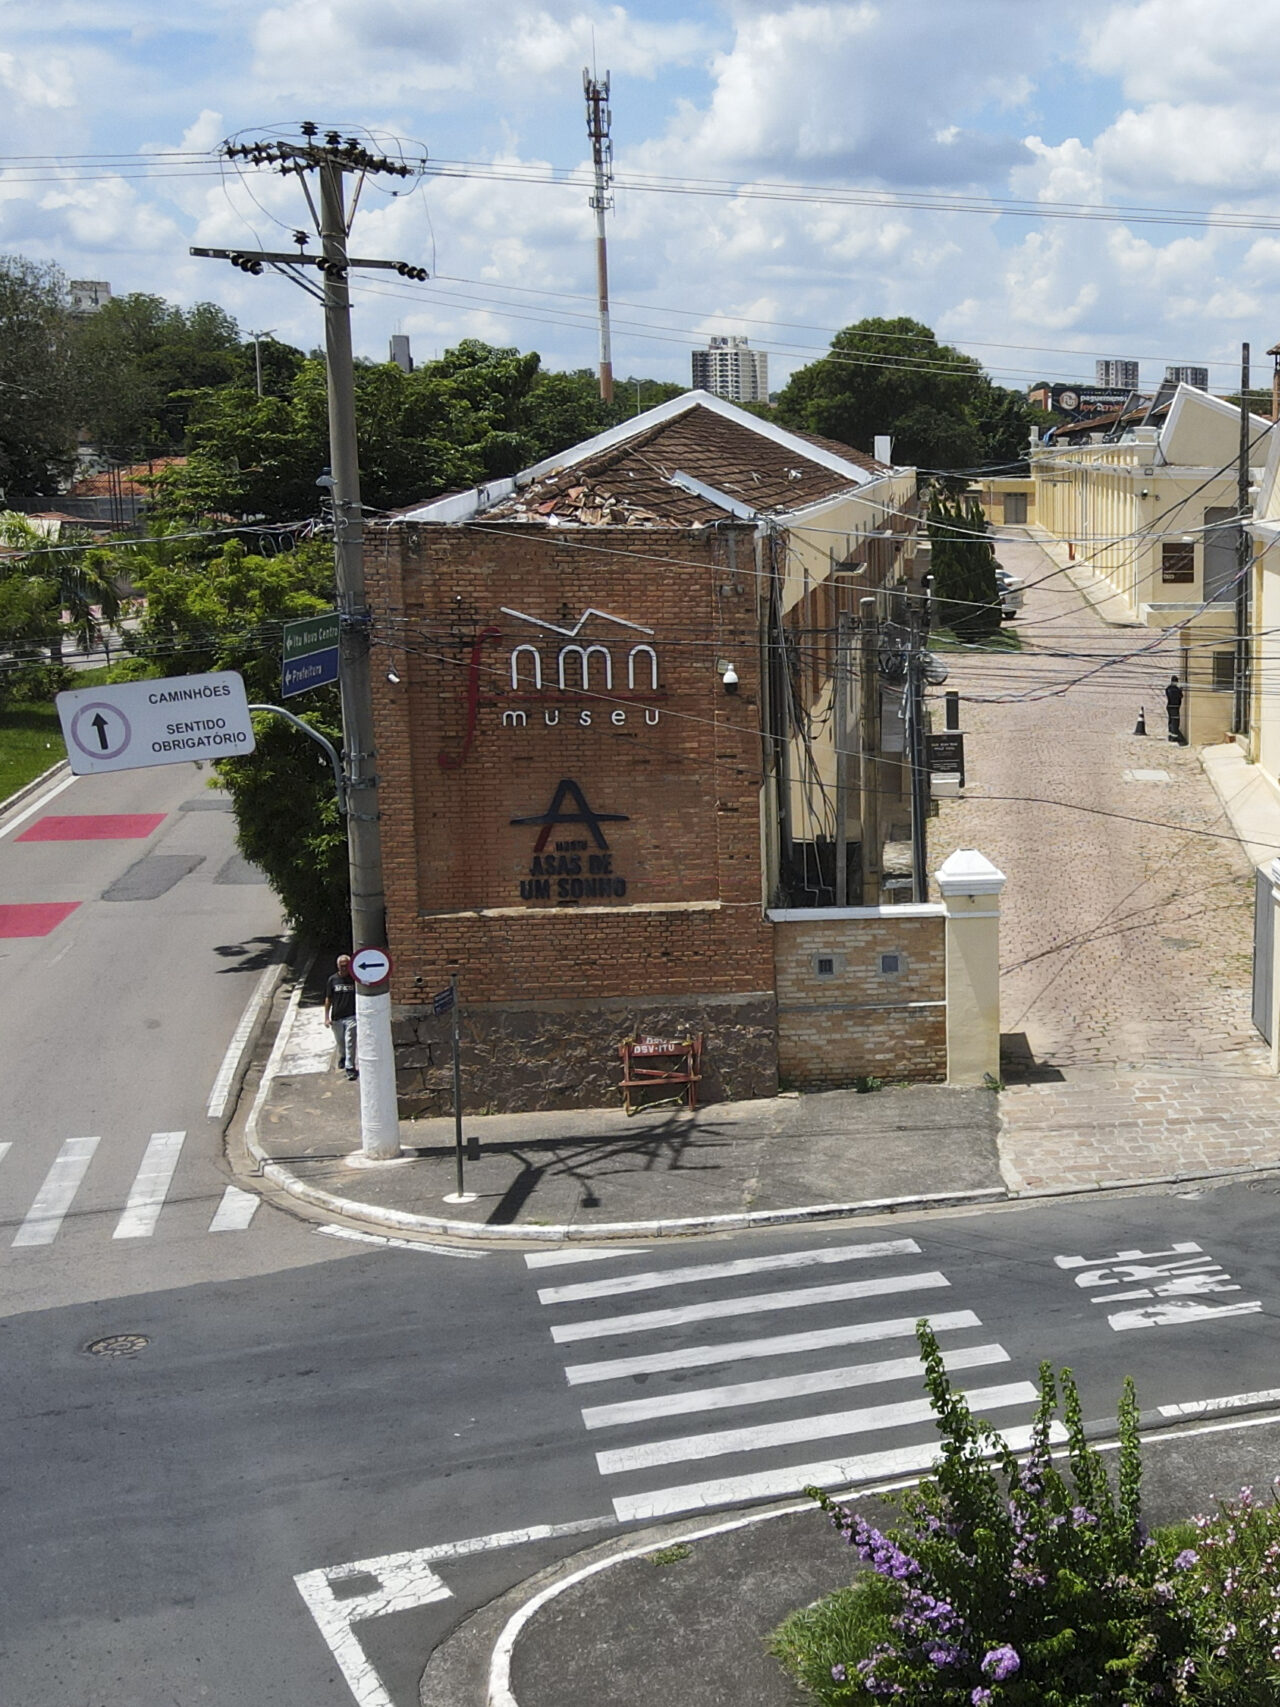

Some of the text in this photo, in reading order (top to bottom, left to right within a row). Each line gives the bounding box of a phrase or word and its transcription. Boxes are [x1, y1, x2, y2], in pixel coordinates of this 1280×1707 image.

[318, 627, 339, 641] Centro
[292, 664, 322, 684] Prefeitura
[148, 684, 231, 705] CAMINHÕES
[166, 717, 226, 735] SENTIDO
[502, 708, 660, 727] museu
[151, 731, 247, 753] OBRIGATÓRIO
[520, 877, 627, 901] UM SONHO
